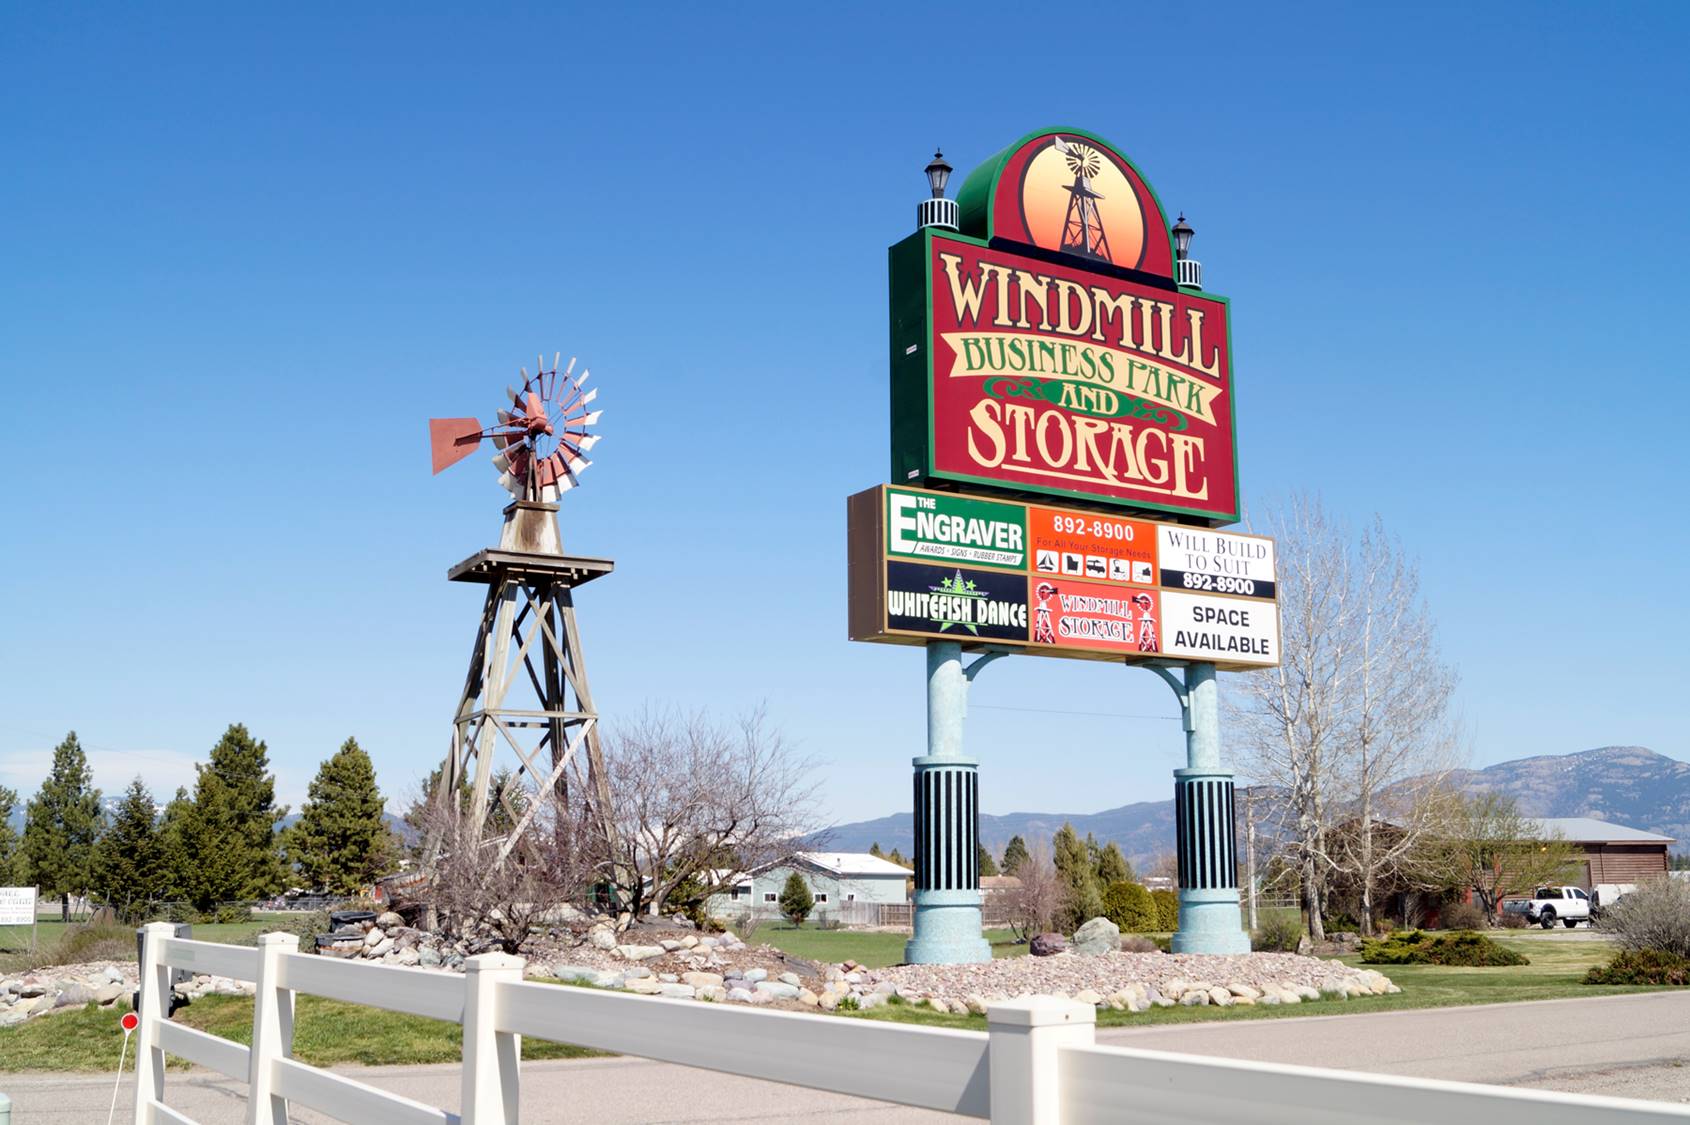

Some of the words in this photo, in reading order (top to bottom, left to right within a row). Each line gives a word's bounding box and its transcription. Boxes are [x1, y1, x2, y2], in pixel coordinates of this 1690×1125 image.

[939, 251, 1220, 379] WINDMILL
[960, 337, 1114, 383] BUSINESS
[1126, 358, 1205, 415] PARK
[1058, 382, 1119, 415] AND
[968, 398, 1208, 500] STORAGE
[917, 496, 936, 509] THE
[890, 493, 1023, 553] ENGRAVER
[1054, 515, 1134, 541] 892-8900
[919, 545, 945, 555] AWARDS
[951, 548, 967, 557] SIGNS
[973, 550, 995, 560] RUBBER
[996, 553, 1018, 563] STAMPS
[1037, 537, 1049, 546] For
[1054, 539, 1066, 547] All
[1070, 542, 1088, 551] Your
[1091, 544, 1123, 556] Storage
[1126, 548, 1152, 559] Needs
[1168, 530, 1210, 552] WILL
[1216, 537, 1266, 559] BUILD
[1185, 554, 1207, 570] TO
[1213, 555, 1251, 575] SUIT
[1183, 572, 1254, 595] 892-8900
[888, 590, 972, 622] WHITEFISH
[977, 599, 1027, 628] DANCE
[1060, 594, 1133, 620] WINDMILL
[1193, 606, 1250, 627] SPACE
[1059, 615, 1134, 643] STORAGE
[1174, 630, 1269, 655] AVAILABLE
